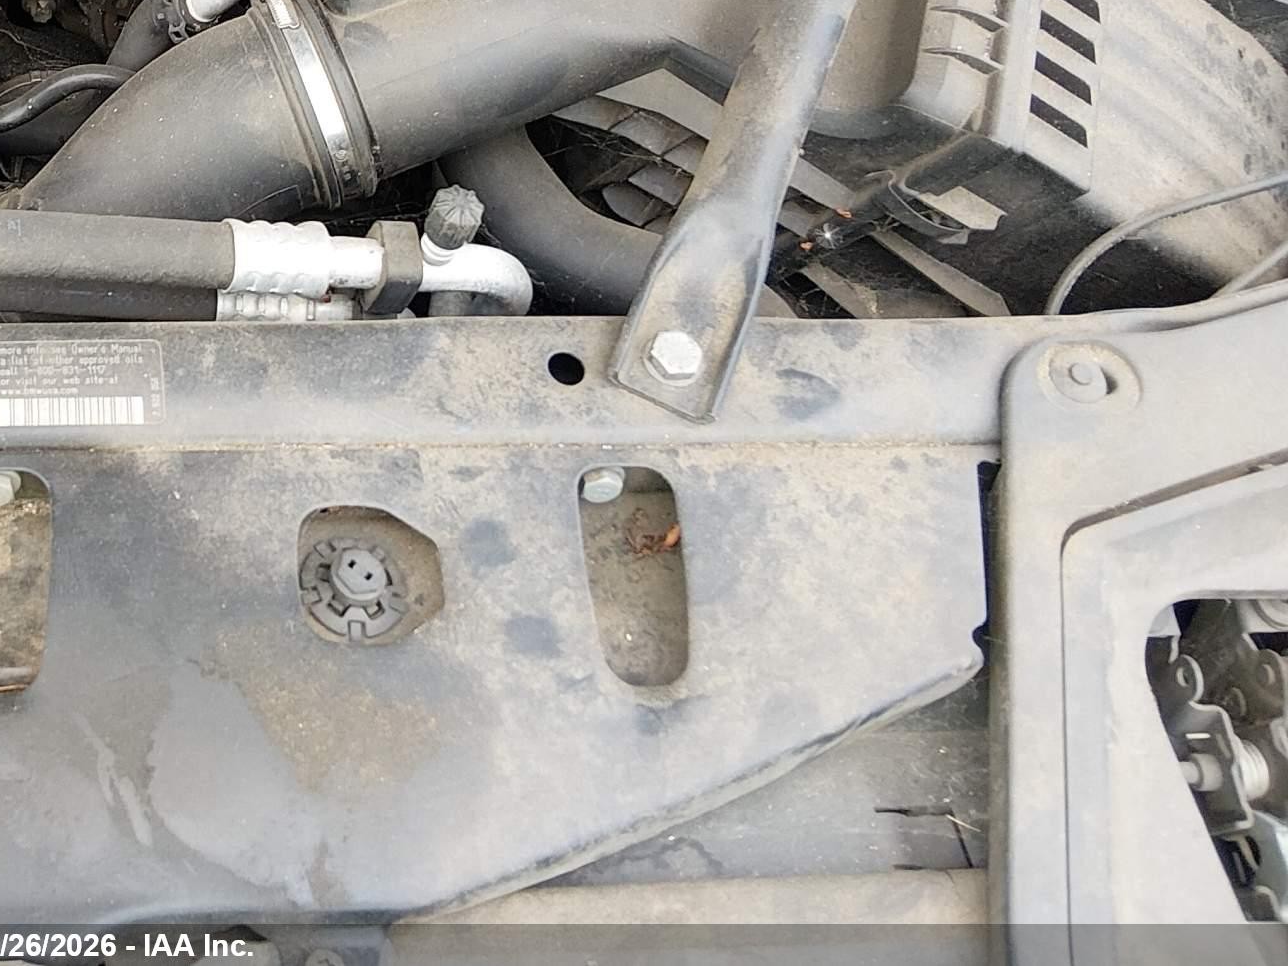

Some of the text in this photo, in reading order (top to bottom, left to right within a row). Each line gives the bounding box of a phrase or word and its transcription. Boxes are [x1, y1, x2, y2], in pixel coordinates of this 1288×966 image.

[0, 345, 22, 355] more
[111, 344, 142, 354] Manual
[78, 354, 121, 367] approved
[124, 354, 143, 364] oils
[0, 378, 10, 386] or
[15, 376, 37, 386] visit
[0, 387, 79, 396] www.bmwusa.com
